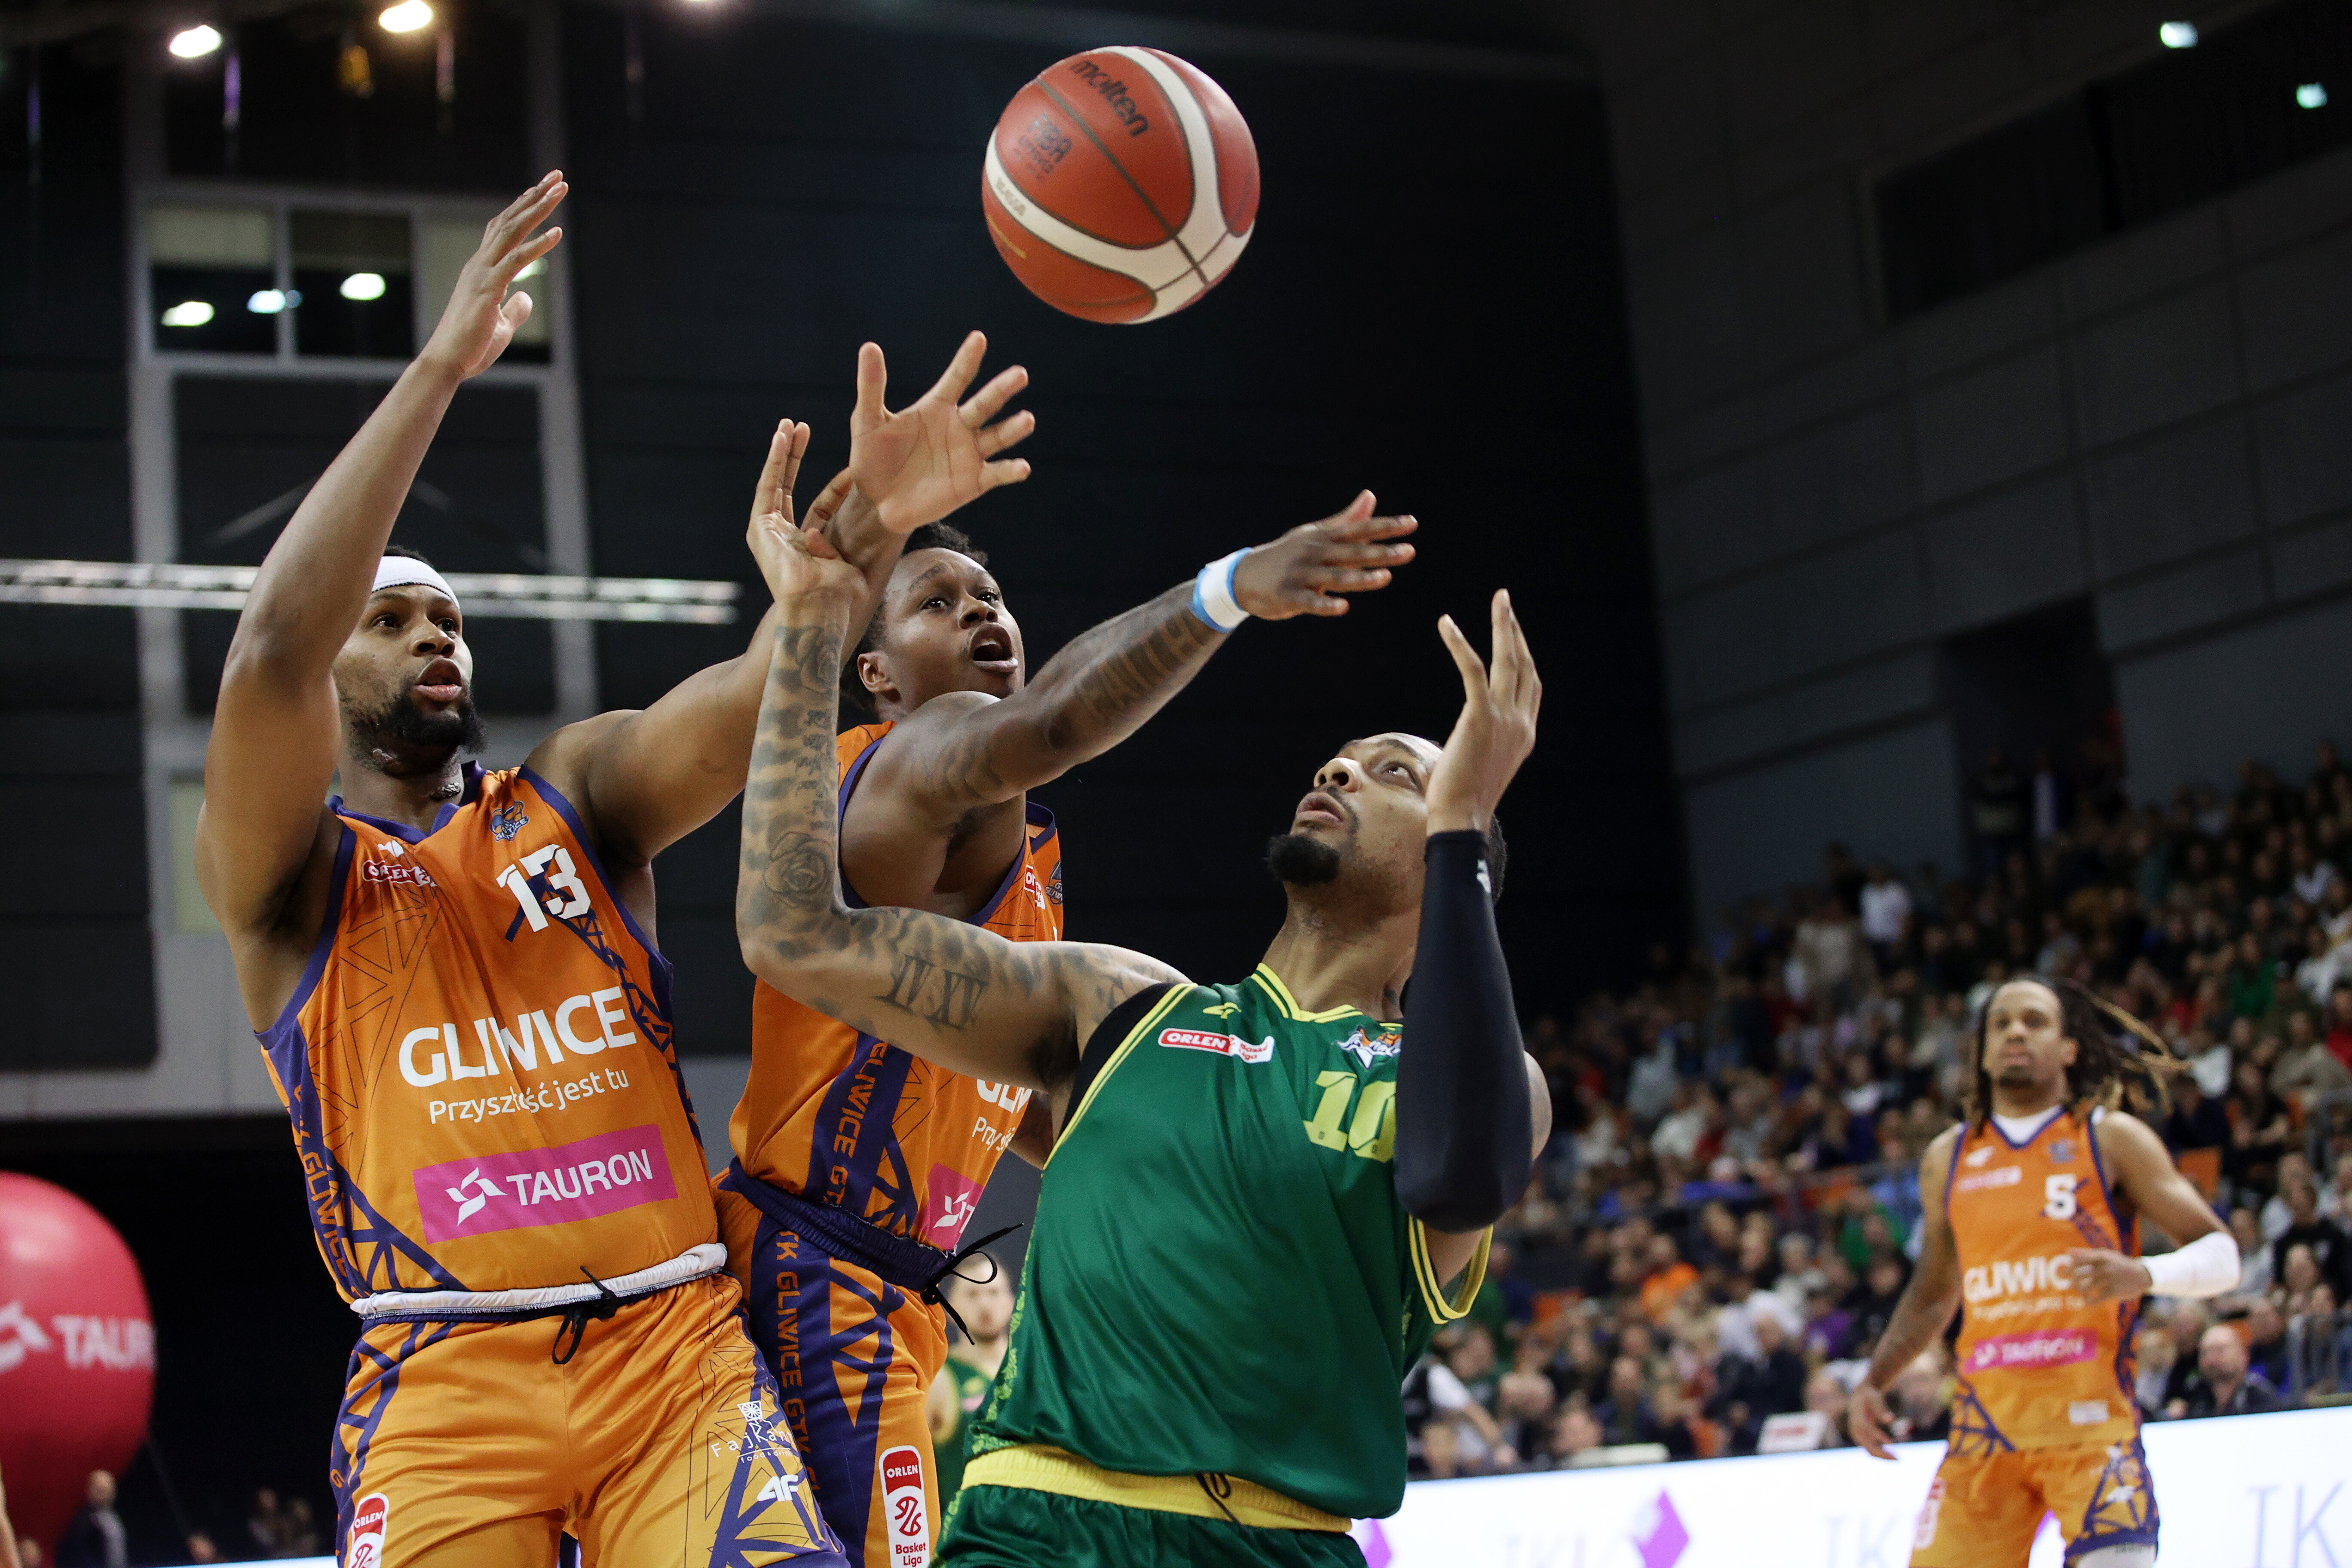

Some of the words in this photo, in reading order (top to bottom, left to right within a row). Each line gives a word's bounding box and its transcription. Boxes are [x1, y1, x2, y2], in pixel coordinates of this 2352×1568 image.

[1069, 60, 1148, 137] molten
[496, 844, 591, 932] 13
[399, 986, 637, 1087] GLIWICE
[1167, 1032, 1226, 1049] ORLEN
[553, 1072, 605, 1111] jest
[605, 1068, 629, 1090] tu
[1303, 1070, 1397, 1163] 10
[506, 1149, 653, 1206] TAURON
[823, 1165, 848, 1204] GT
[2045, 1173, 2077, 1221] 5
[775, 1271, 802, 1389] GLIWICE
[756, 1474, 799, 1501] 4F
[886, 1464, 919, 1478] ORLEN
[355, 1511, 383, 1528] ORLEN
[895, 1542, 926, 1555] Basket
[903, 1556, 922, 1568] Liga
